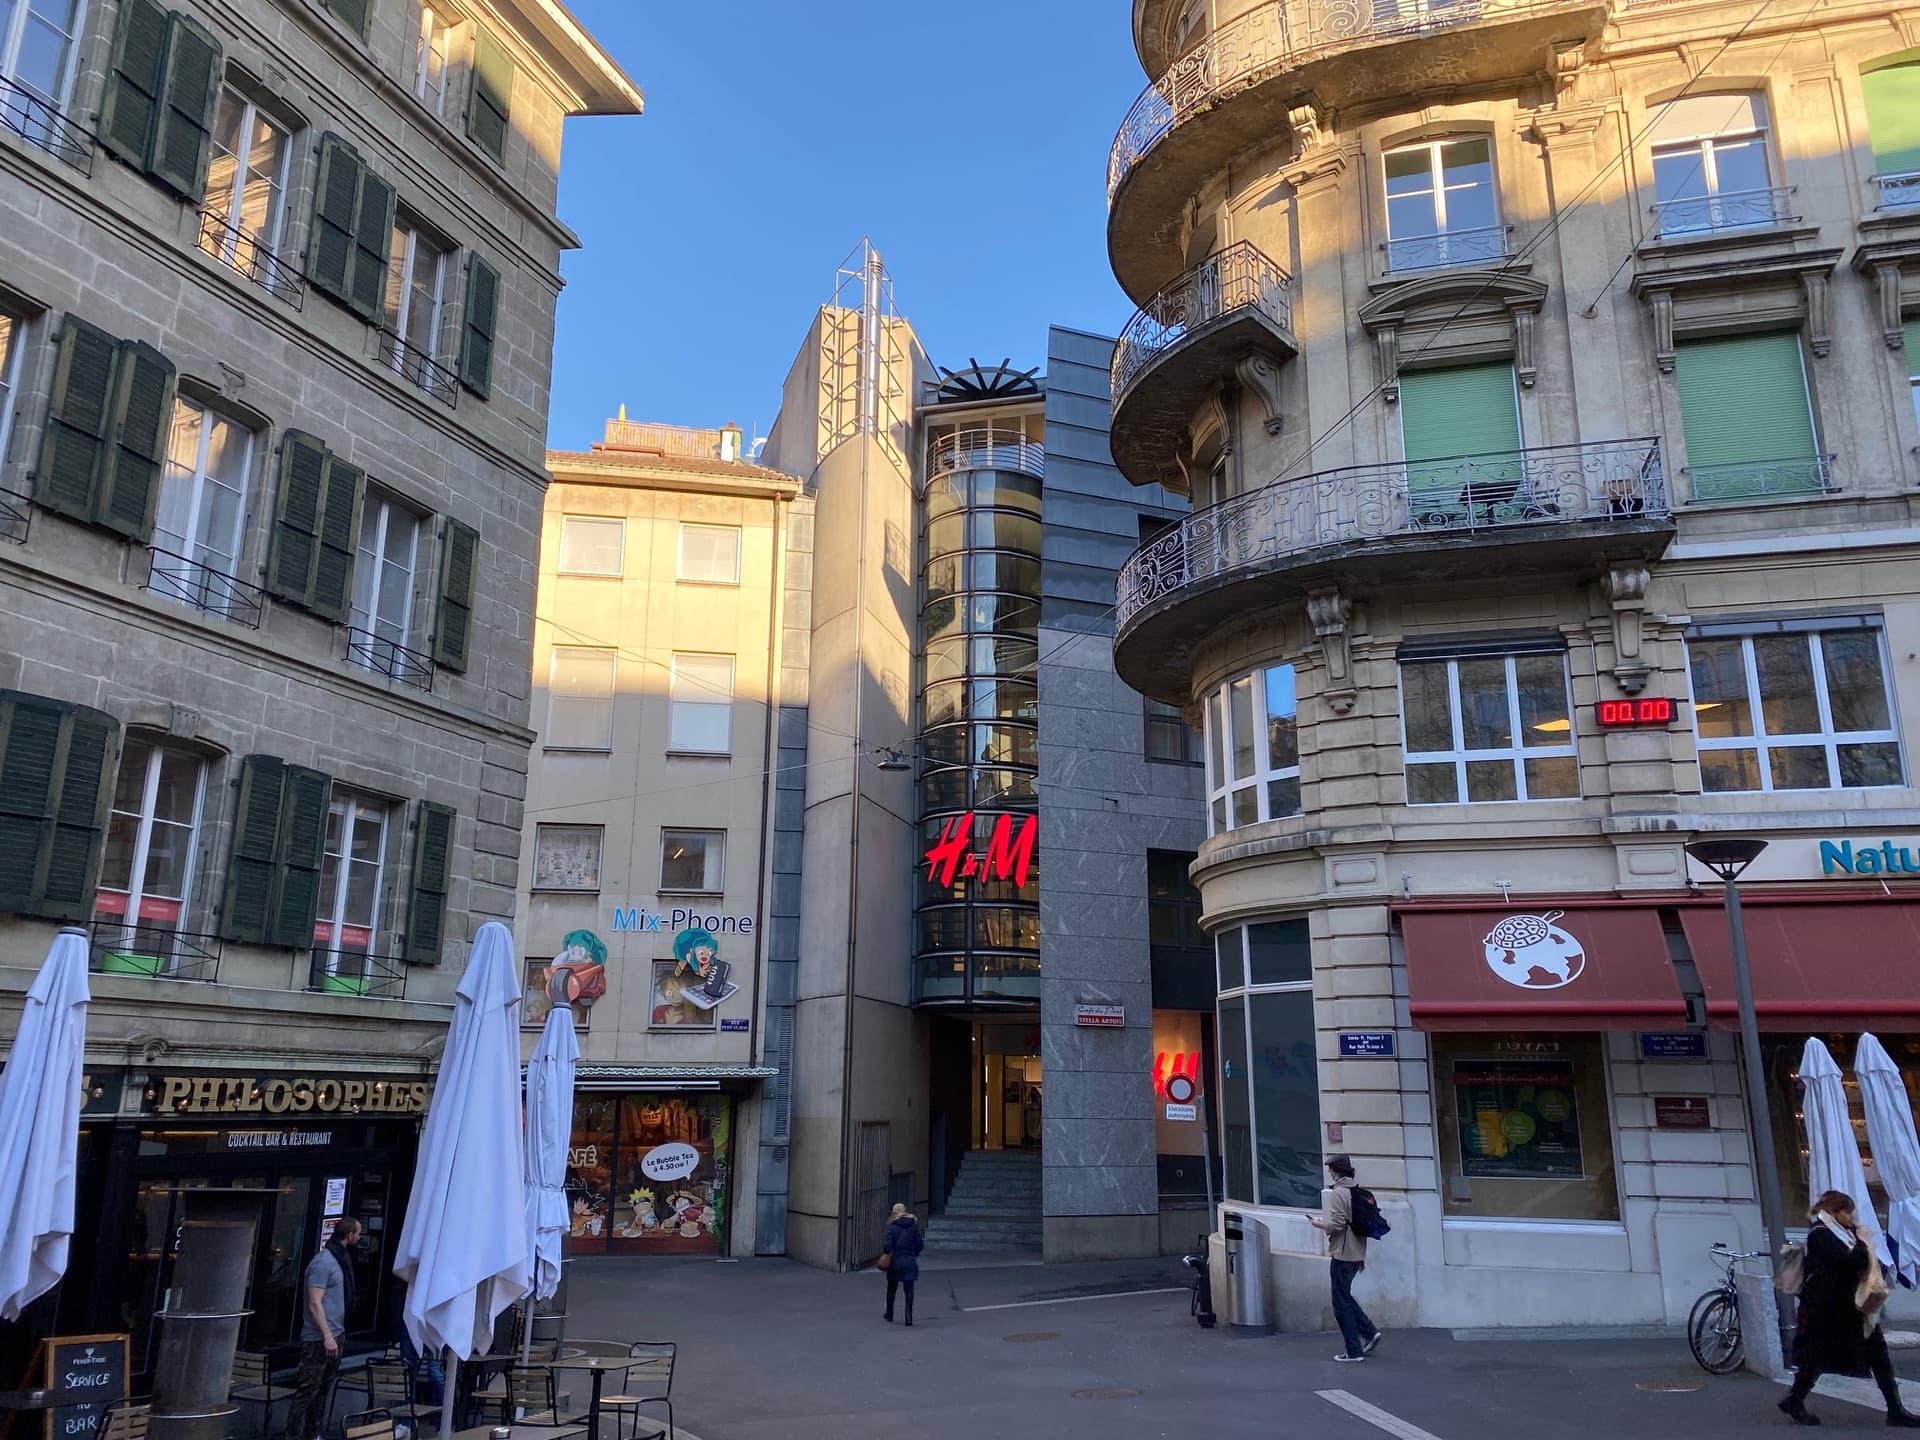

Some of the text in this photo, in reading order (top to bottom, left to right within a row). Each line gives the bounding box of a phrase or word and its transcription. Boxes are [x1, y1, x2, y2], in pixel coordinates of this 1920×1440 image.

[925, 811, 1038, 889] H&M
[613, 907, 753, 934] Mix-Phone
[156, 1077, 427, 1112] PHILOSOPHES
[228, 1132, 332, 1148] COCKTAIL BAR & RESTAURANT
[656, 1155, 680, 1165] Bubble
[65, 1415, 97, 1434] BAR
